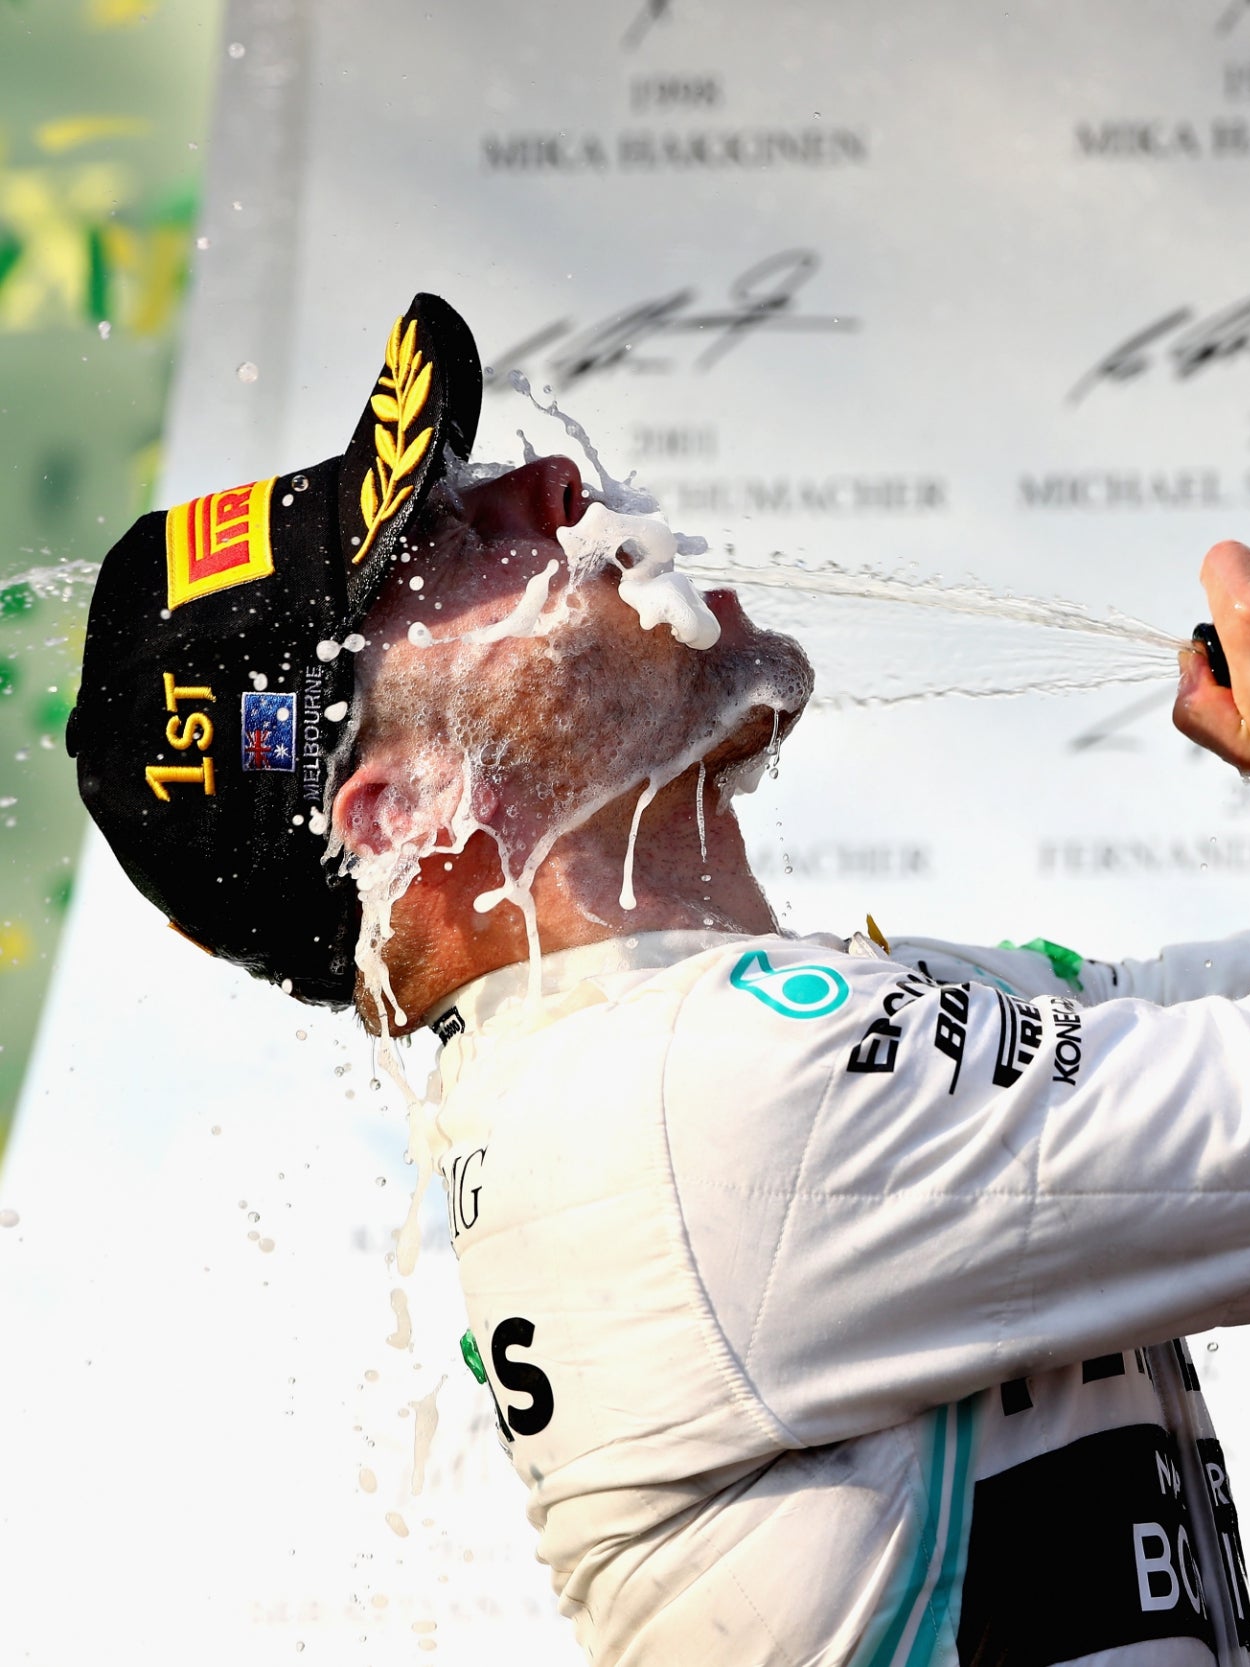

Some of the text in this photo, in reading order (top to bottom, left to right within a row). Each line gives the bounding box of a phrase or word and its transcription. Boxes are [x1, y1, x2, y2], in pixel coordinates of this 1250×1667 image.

[482, 131, 608, 174] MIKA
[1075, 117, 1200, 158] MIKA
[1018, 466, 1224, 510] MICHAEL
[145, 672, 217, 803] 1ST
[303, 665, 323, 802] MELBOURNE
[992, 988, 1043, 1088] PIRE
